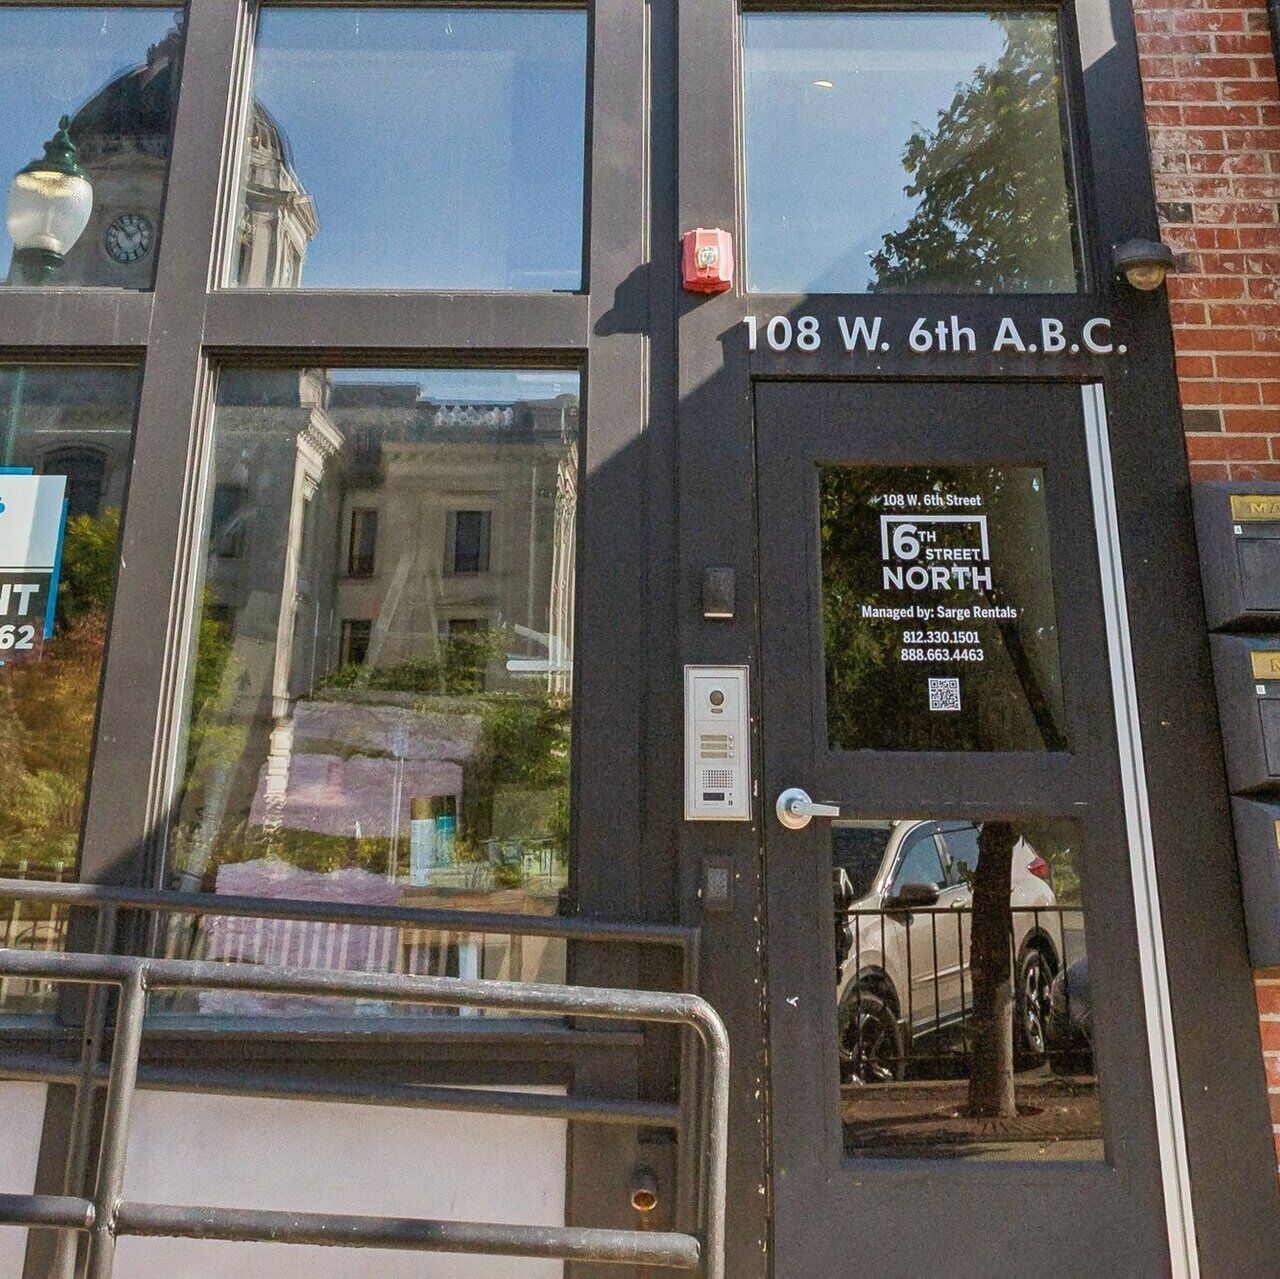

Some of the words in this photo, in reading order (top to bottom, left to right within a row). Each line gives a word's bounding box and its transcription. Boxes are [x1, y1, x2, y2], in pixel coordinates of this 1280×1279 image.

[744, 316, 821, 351] 108
[838, 317, 890, 351] W.
[909, 315, 977, 352] 6th
[993, 317, 1127, 353] A.B.C.
[883, 494, 904, 506] 108
[907, 494, 921, 506] W.
[924, 493, 943, 506] 6th
[946, 494, 982, 506] Street
[925, 548, 981, 561] STREET
[883, 567, 993, 590] NORTH
[861, 605, 914, 619] Managed
[917, 605, 934, 620] by:
[937, 605, 970, 621] Sarge
[972, 605, 1018, 619] Rentals
[902, 631, 980, 644] 812.330.1501
[901, 648, 984, 662] 888.663.4463
